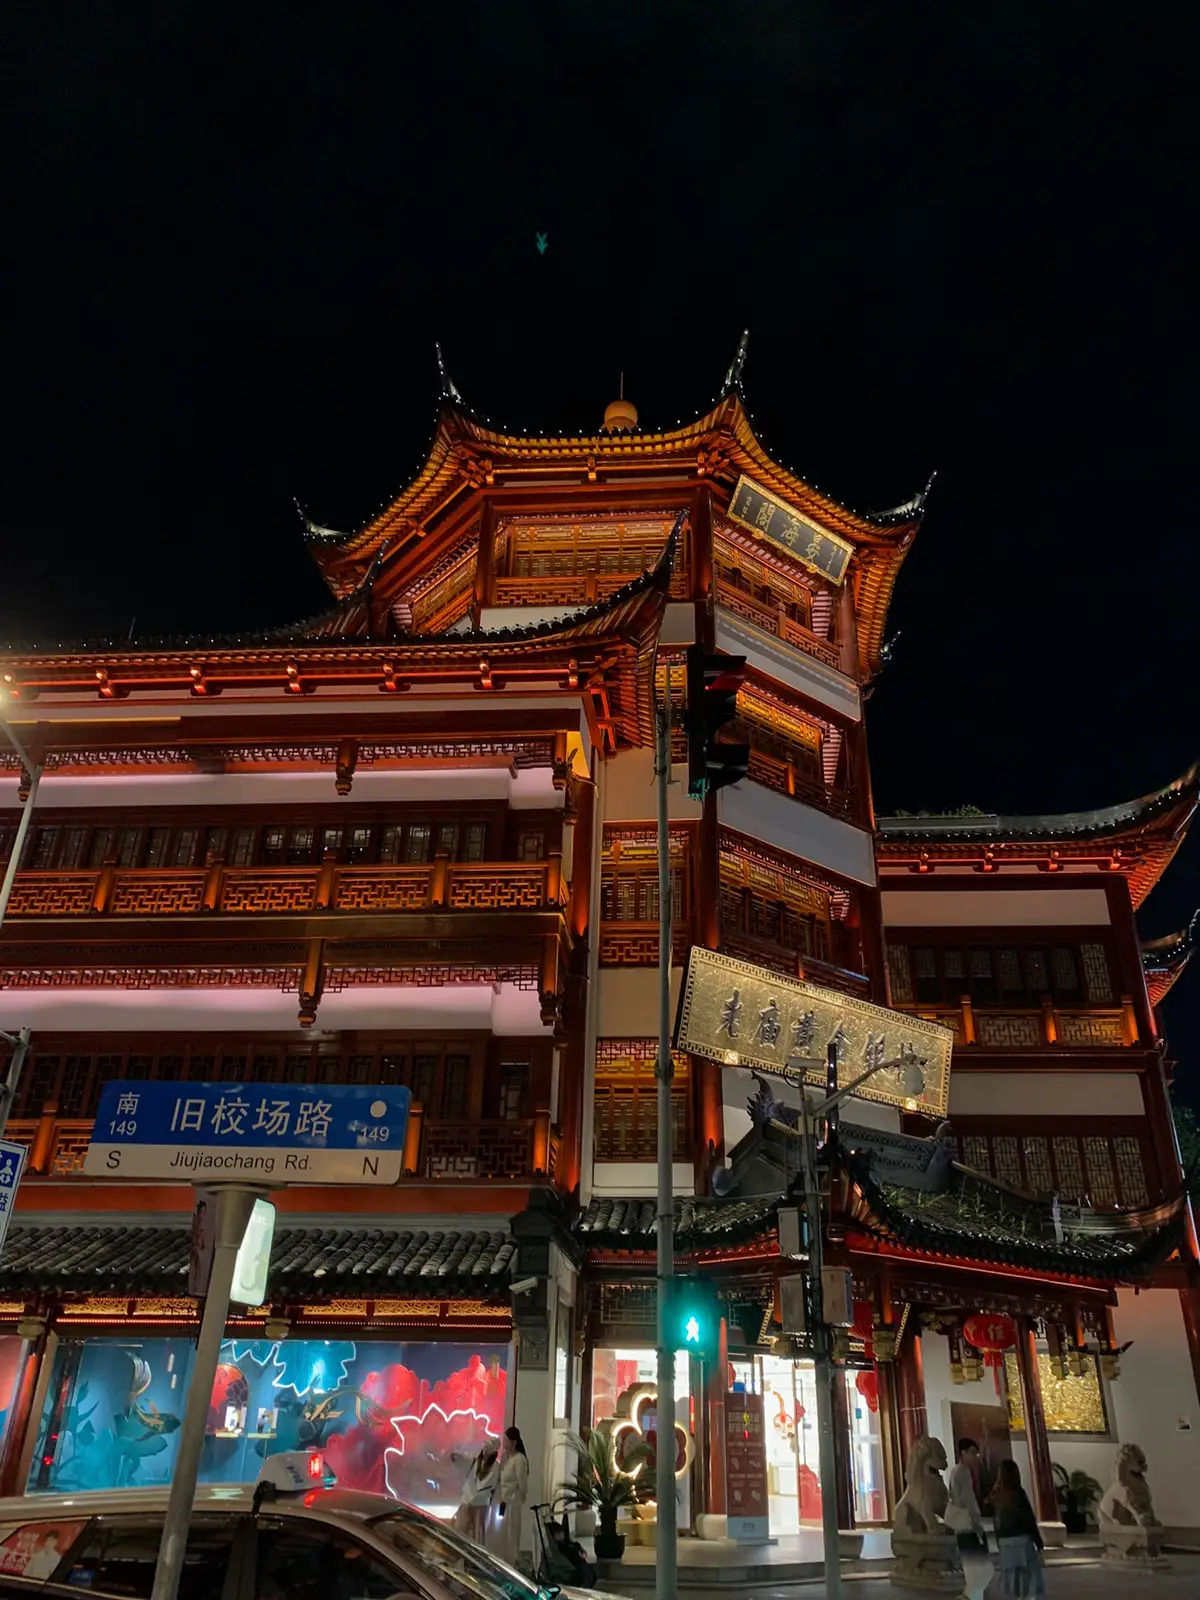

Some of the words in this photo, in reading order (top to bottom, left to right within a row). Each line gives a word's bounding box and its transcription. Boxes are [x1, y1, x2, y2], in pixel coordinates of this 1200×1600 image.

[117, 1091, 140, 1116] 南
[170, 1097, 333, 1138] 旧校场路
[109, 1120, 137, 1136] 149
[361, 1126, 390, 1142] 149
[106, 1150, 121, 1170] S
[170, 1151, 275, 1173] Jiujiaochang
[285, 1154, 312, 1171] Rd.
[362, 1156, 379, 1176] N
